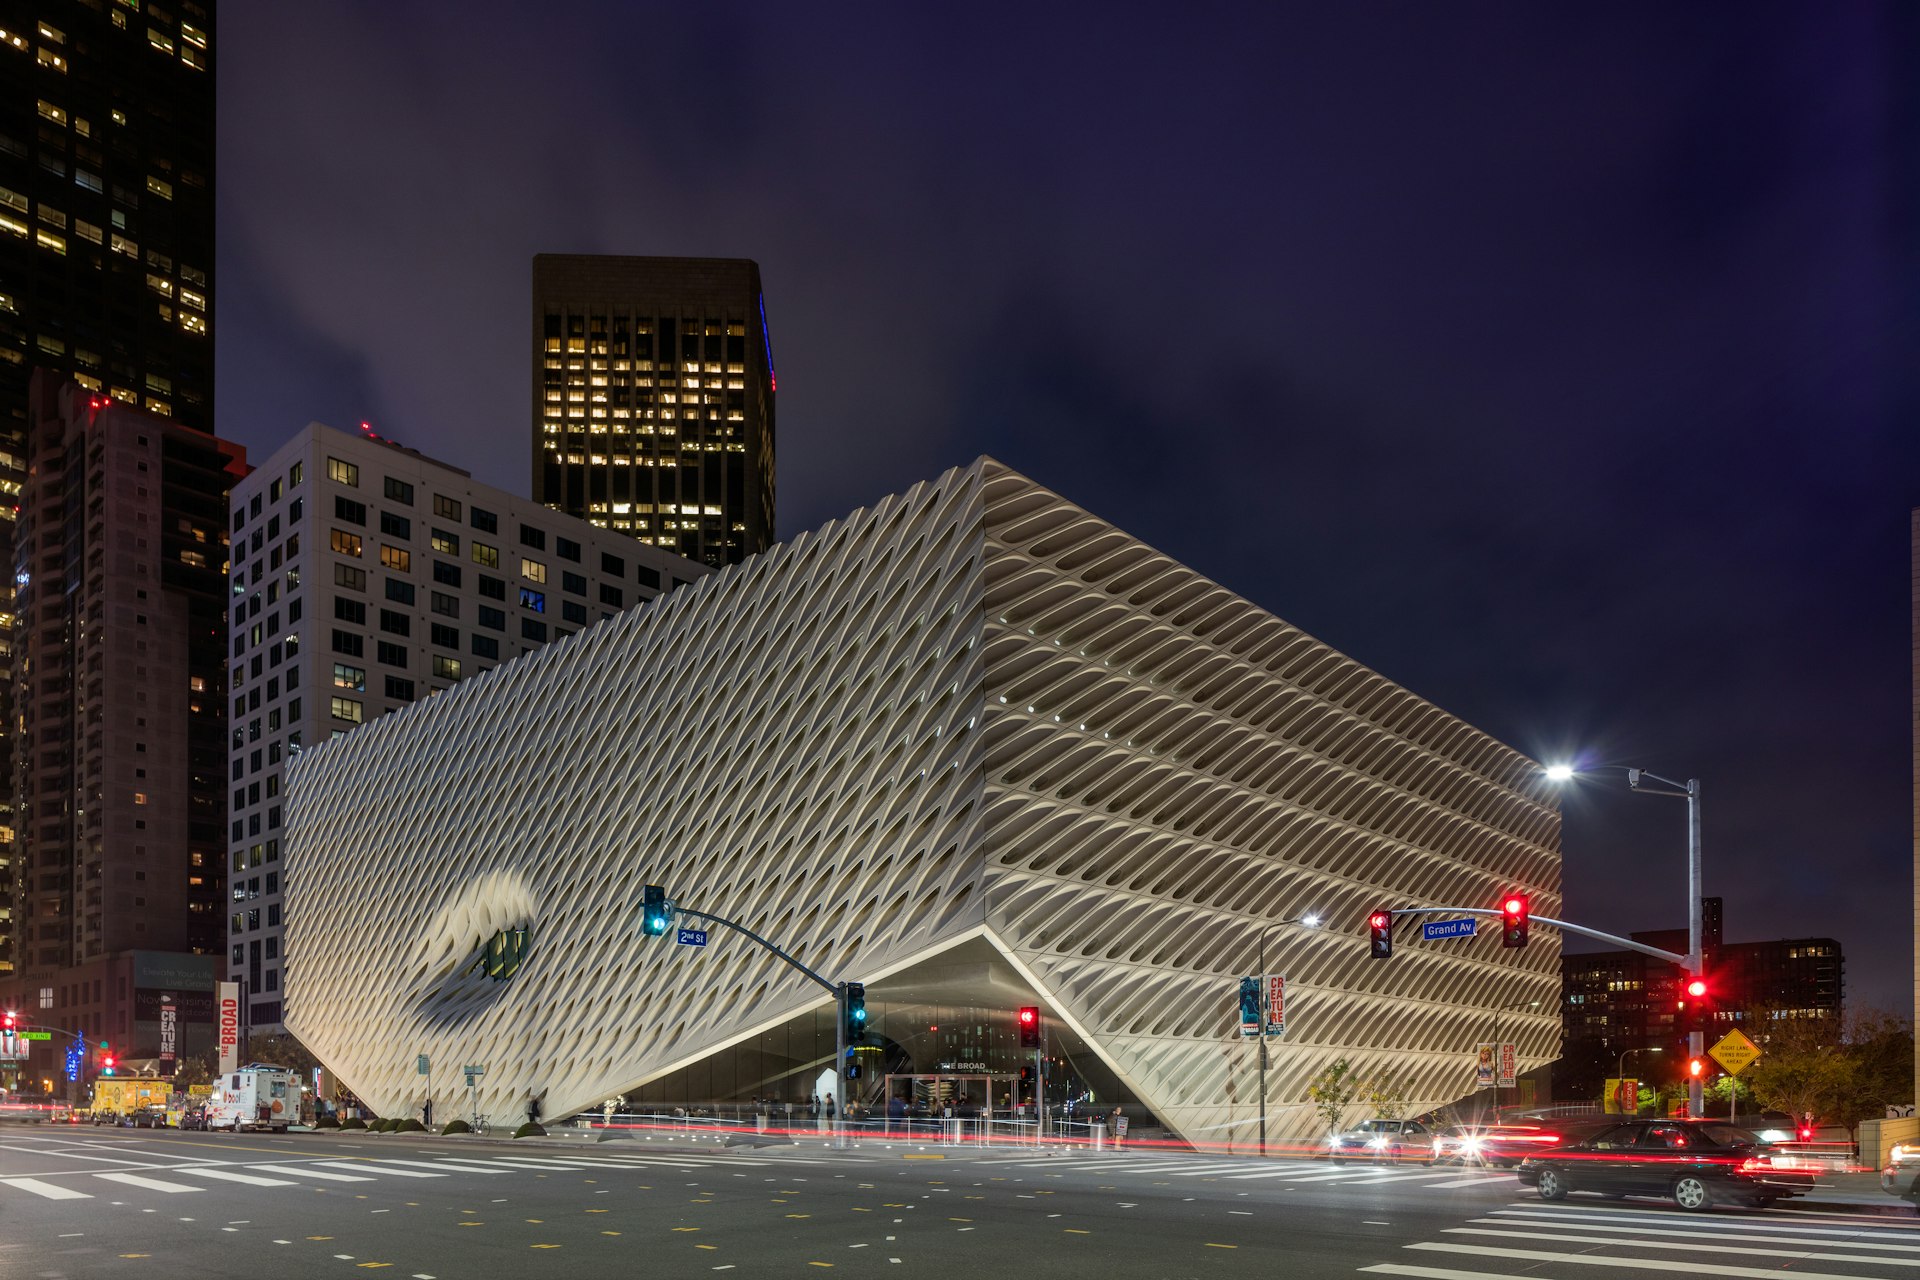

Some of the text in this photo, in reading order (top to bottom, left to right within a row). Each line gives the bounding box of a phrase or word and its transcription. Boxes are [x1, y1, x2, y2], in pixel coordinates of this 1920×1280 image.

[1428, 922, 1472, 935] Grand Av
[680, 931, 704, 944] 2nd St
[177, 968, 195, 978] Your
[185, 978, 213, 988] Grand
[221, 999, 237, 1058] THE BROAD
[940, 1062, 986, 1070] THE BROAD
